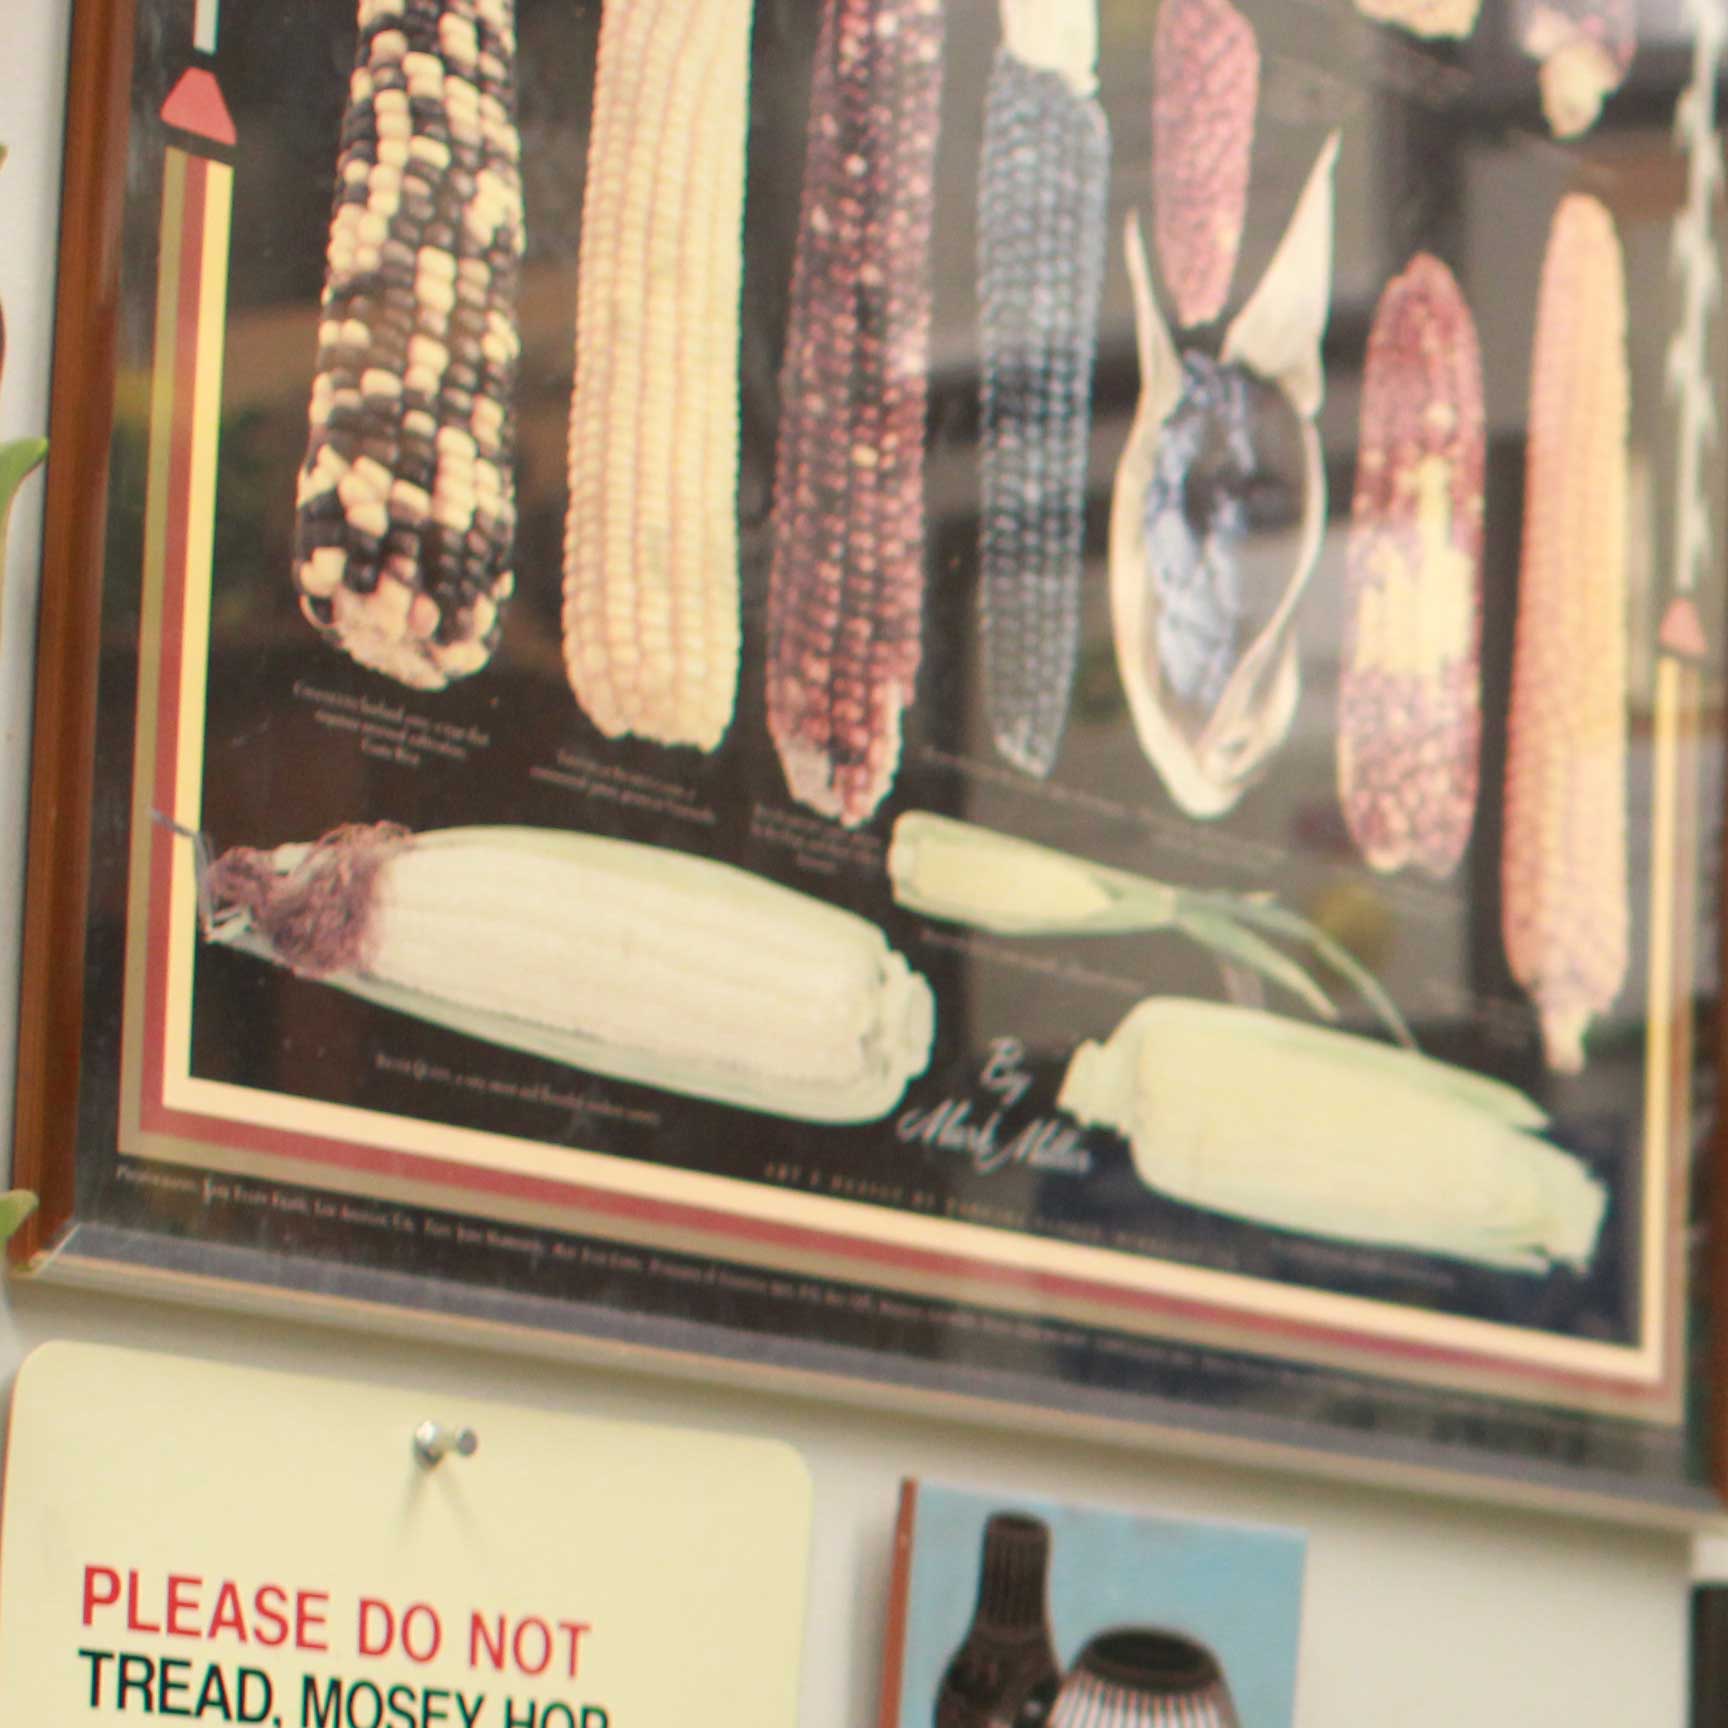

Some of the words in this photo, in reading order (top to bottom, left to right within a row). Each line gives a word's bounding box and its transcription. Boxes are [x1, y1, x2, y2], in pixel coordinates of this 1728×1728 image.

[83, 1565, 329, 1651] PLEASE
[359, 1598, 442, 1663] DO
[470, 1612, 590, 1678] NOT
